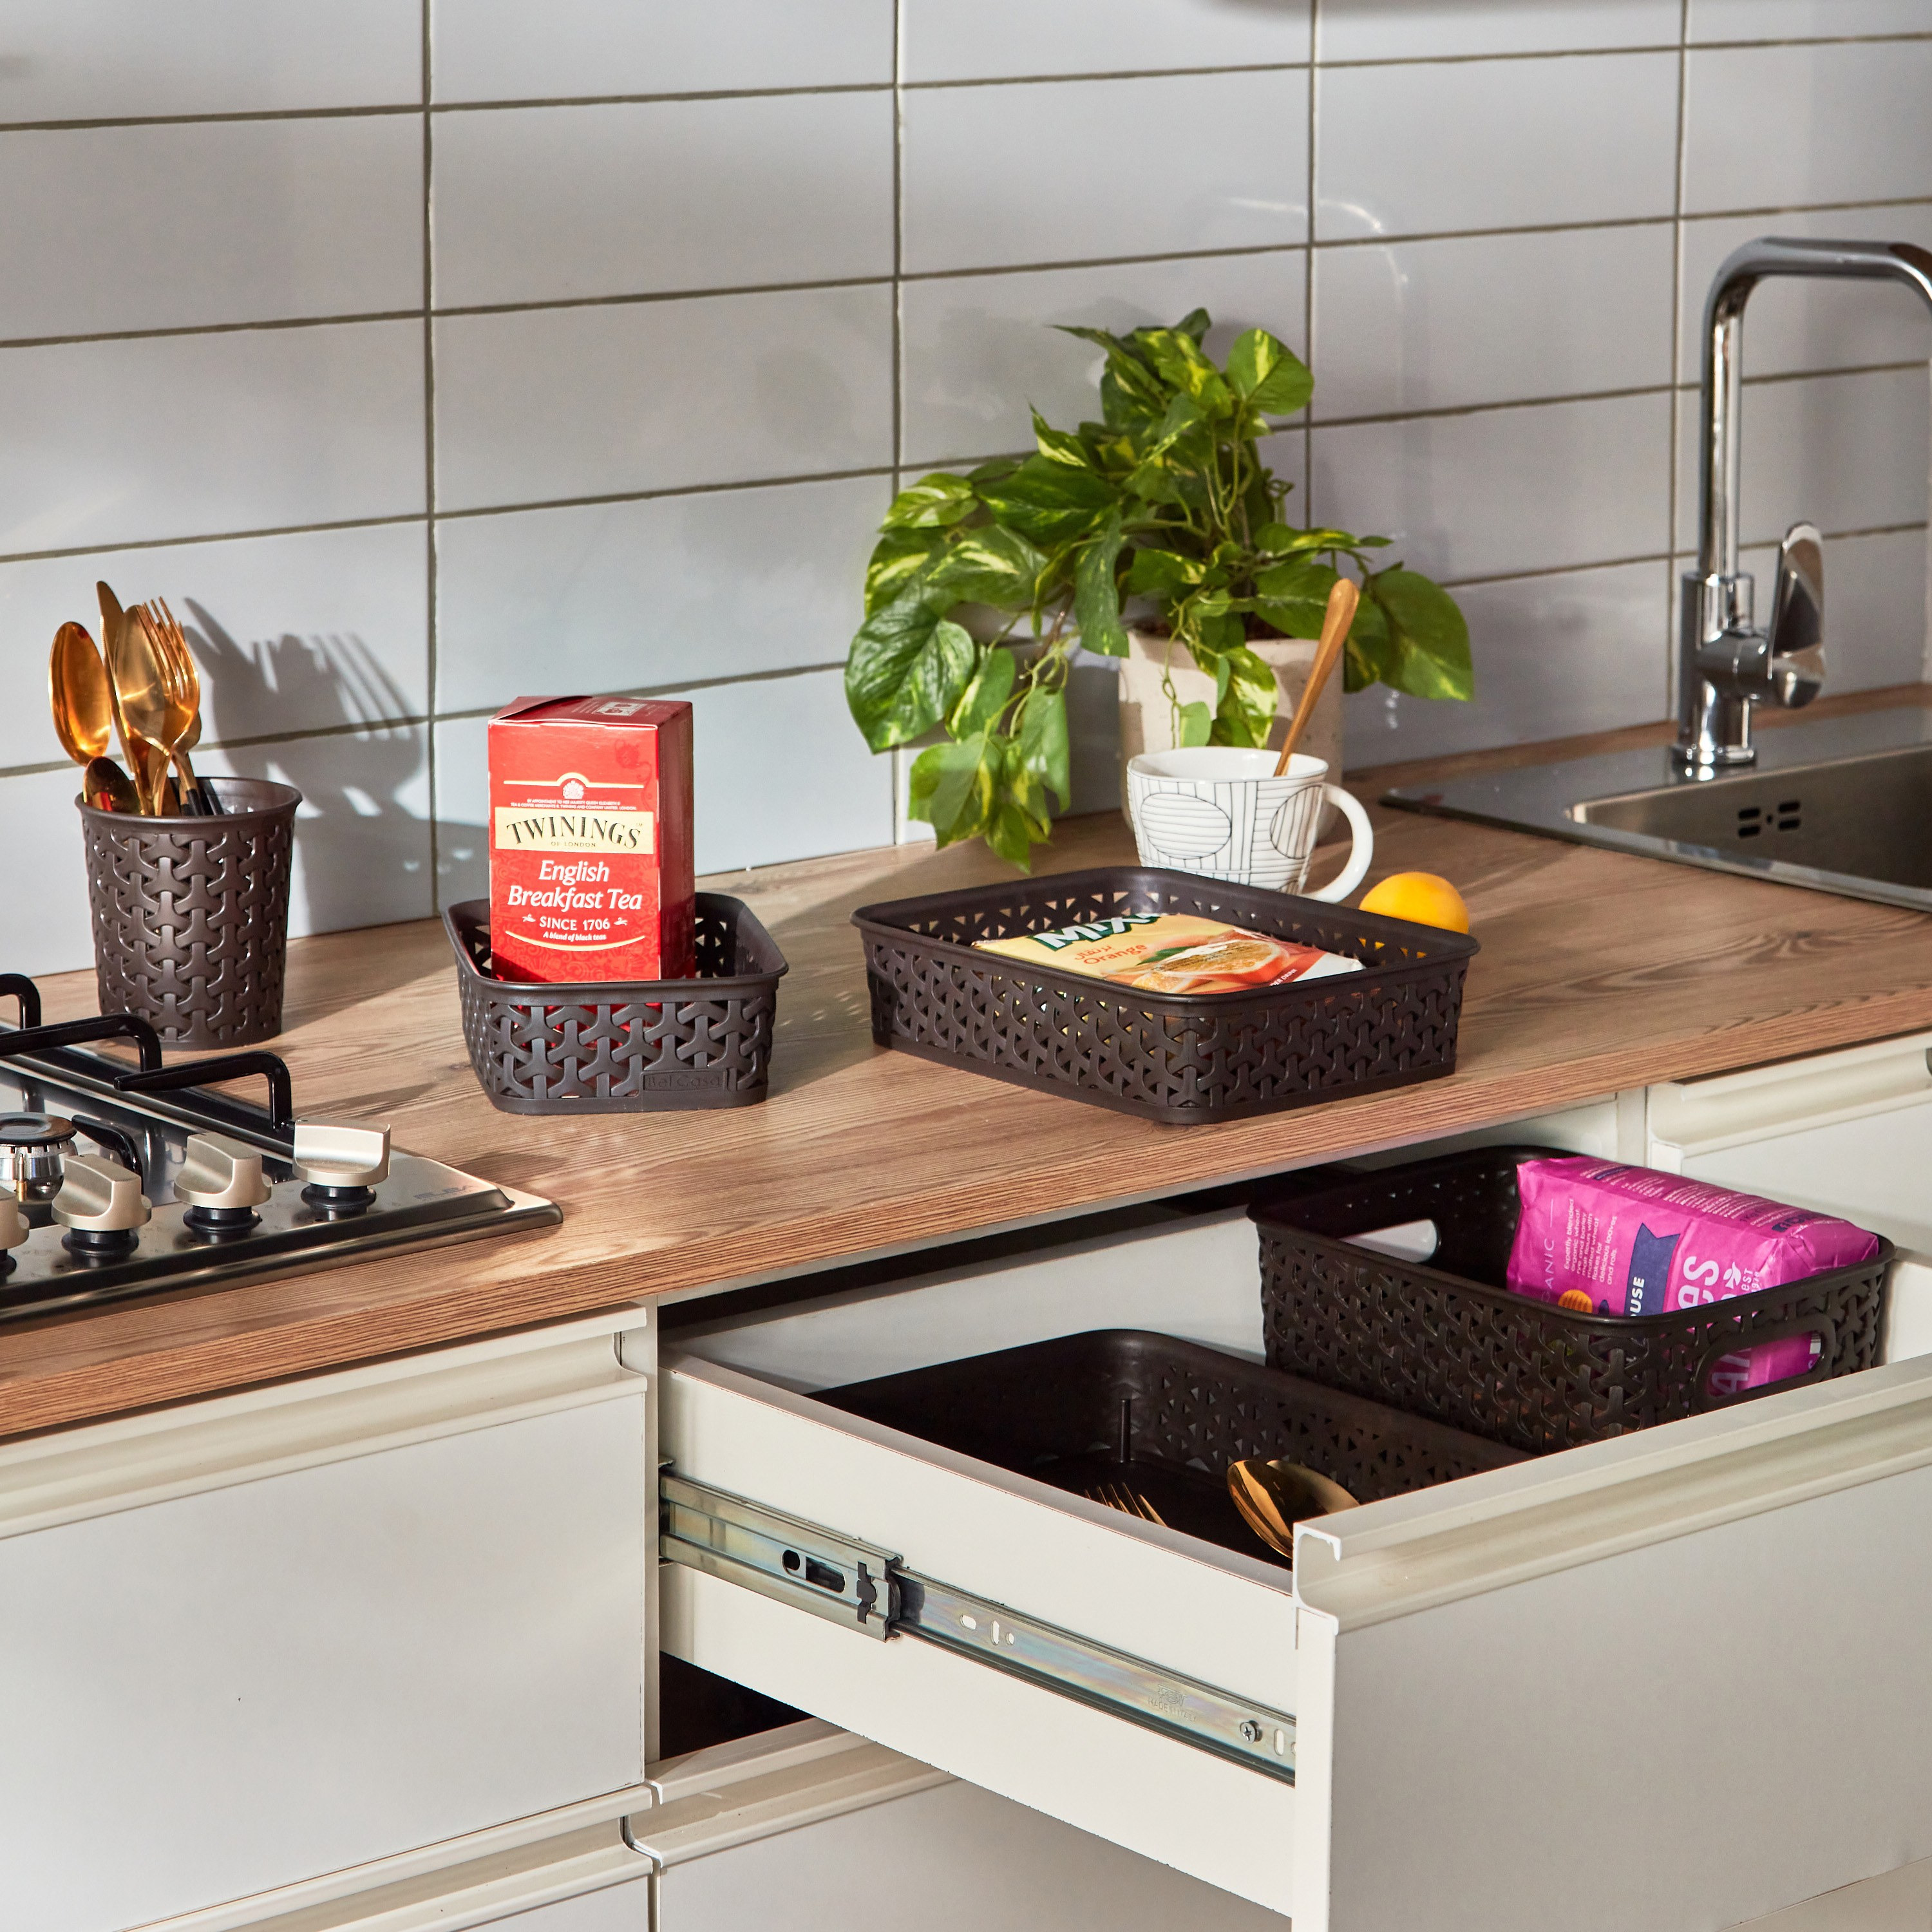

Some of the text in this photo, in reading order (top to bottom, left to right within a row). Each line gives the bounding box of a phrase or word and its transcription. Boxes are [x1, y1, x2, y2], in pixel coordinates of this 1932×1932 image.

[506, 816, 641, 849] TWININGS
[538, 860, 610, 886] English
[507, 885, 643, 913] Breakfast Tea
[539, 916, 611, 931] SINCE 1706
[1032, 913, 1160, 949] MIX
[567, 933, 576, 942] of
[1074, 945, 1112, 960] برتقال
[1083, 945, 1148, 965] Orange
[648, 1074, 720, 1088] Bel Casa
[1564, 1236, 1572, 1269] Expertly
[1600, 1216, 1617, 1282] delicious loaves
[1592, 1256, 1600, 1280] flakes
